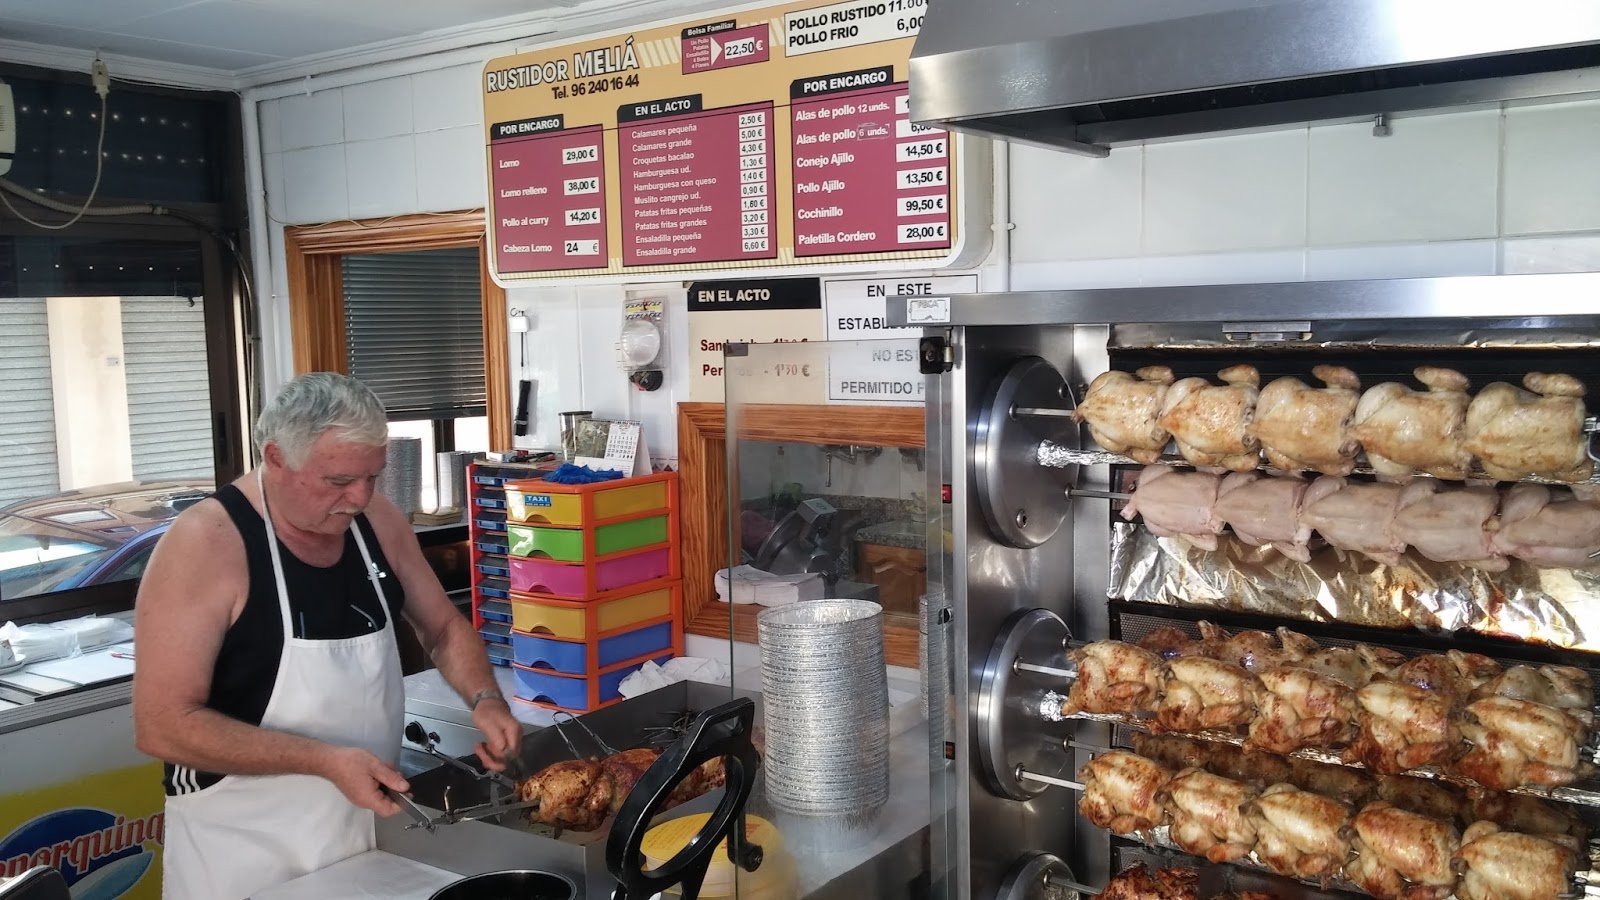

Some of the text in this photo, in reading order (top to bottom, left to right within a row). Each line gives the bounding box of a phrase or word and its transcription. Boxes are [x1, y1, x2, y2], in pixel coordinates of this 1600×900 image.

[790, 14, 827, 31] POLLO
[831, 3, 885, 24] RUSTIDO
[687, 22, 734, 36] Bolsa Familiar
[789, 31, 827, 47] POLLO
[831, 25, 858, 40] FRIO
[726, 40, 763, 56] 22,50 €
[486, 35, 639, 94] RUSTIDOR MELIÁ
[552, 74, 639, 100] Tel. 96 240 16 44
[804, 71, 887, 93] POR ENCARGO
[635, 100, 691, 116] EN EL ACTO
[796, 102, 890, 121] Alas de pollo 12 unds.
[500, 119, 559, 135] POR ENCARGO
[632, 115, 762, 139] Calamares pequeña 2,50 €
[796, 134, 816, 145] Alas
[818, 132, 830, 142] de
[833, 129, 856, 143] pollo
[859, 128, 864, 137] 6
[867, 127, 888, 136] unds.
[632, 141, 666, 152] Calamares
[668, 138, 692, 150] grande
[741, 130, 756, 140] 5,00
[500, 149, 594, 168] Lomo 29,00 €
[632, 143, 763, 166] Croquetas bacalao 4,30 €
[797, 143, 942, 168] Conejo Ajillo 14,50 €
[633, 157, 763, 179] Hamburguesa ud. 1,30 €
[501, 180, 595, 198] Lomo relleno 38,00 €
[634, 171, 764, 192] Hamburguesa con queso 1,40 €
[797, 171, 942, 193] Pollo Ajillo 13,50 €
[634, 185, 764, 205] Muslito cangrejo ud. 0,90 €
[635, 209, 659, 217] Patatas
[660, 207, 677, 216] fritas
[679, 205, 712, 215] pequeñas
[760, 199, 764, 207] €
[798, 198, 943, 219] Cochinillo 99,50 €
[503, 211, 597, 227] Pollo al curry 14,20 €
[635, 213, 765, 231] Patatas fritas grandes 3,20 €
[636, 227, 765, 244] Ensaladilla pequeña 3,30 €
[799, 226, 943, 245] Paletilla Cordero 28,00 €
[503, 243, 598, 253] Cabeza Lomo 24 €
[636, 240, 765, 257] Ensaladilla grande 6,60 €
[698, 289, 770, 302] EN EL ACTO
[867, 283, 932, 297] EN ESTE
[873, 350, 891, 361] NO
[802, 365, 809, 376] €
[841, 382, 912, 394] PERMITIDO
